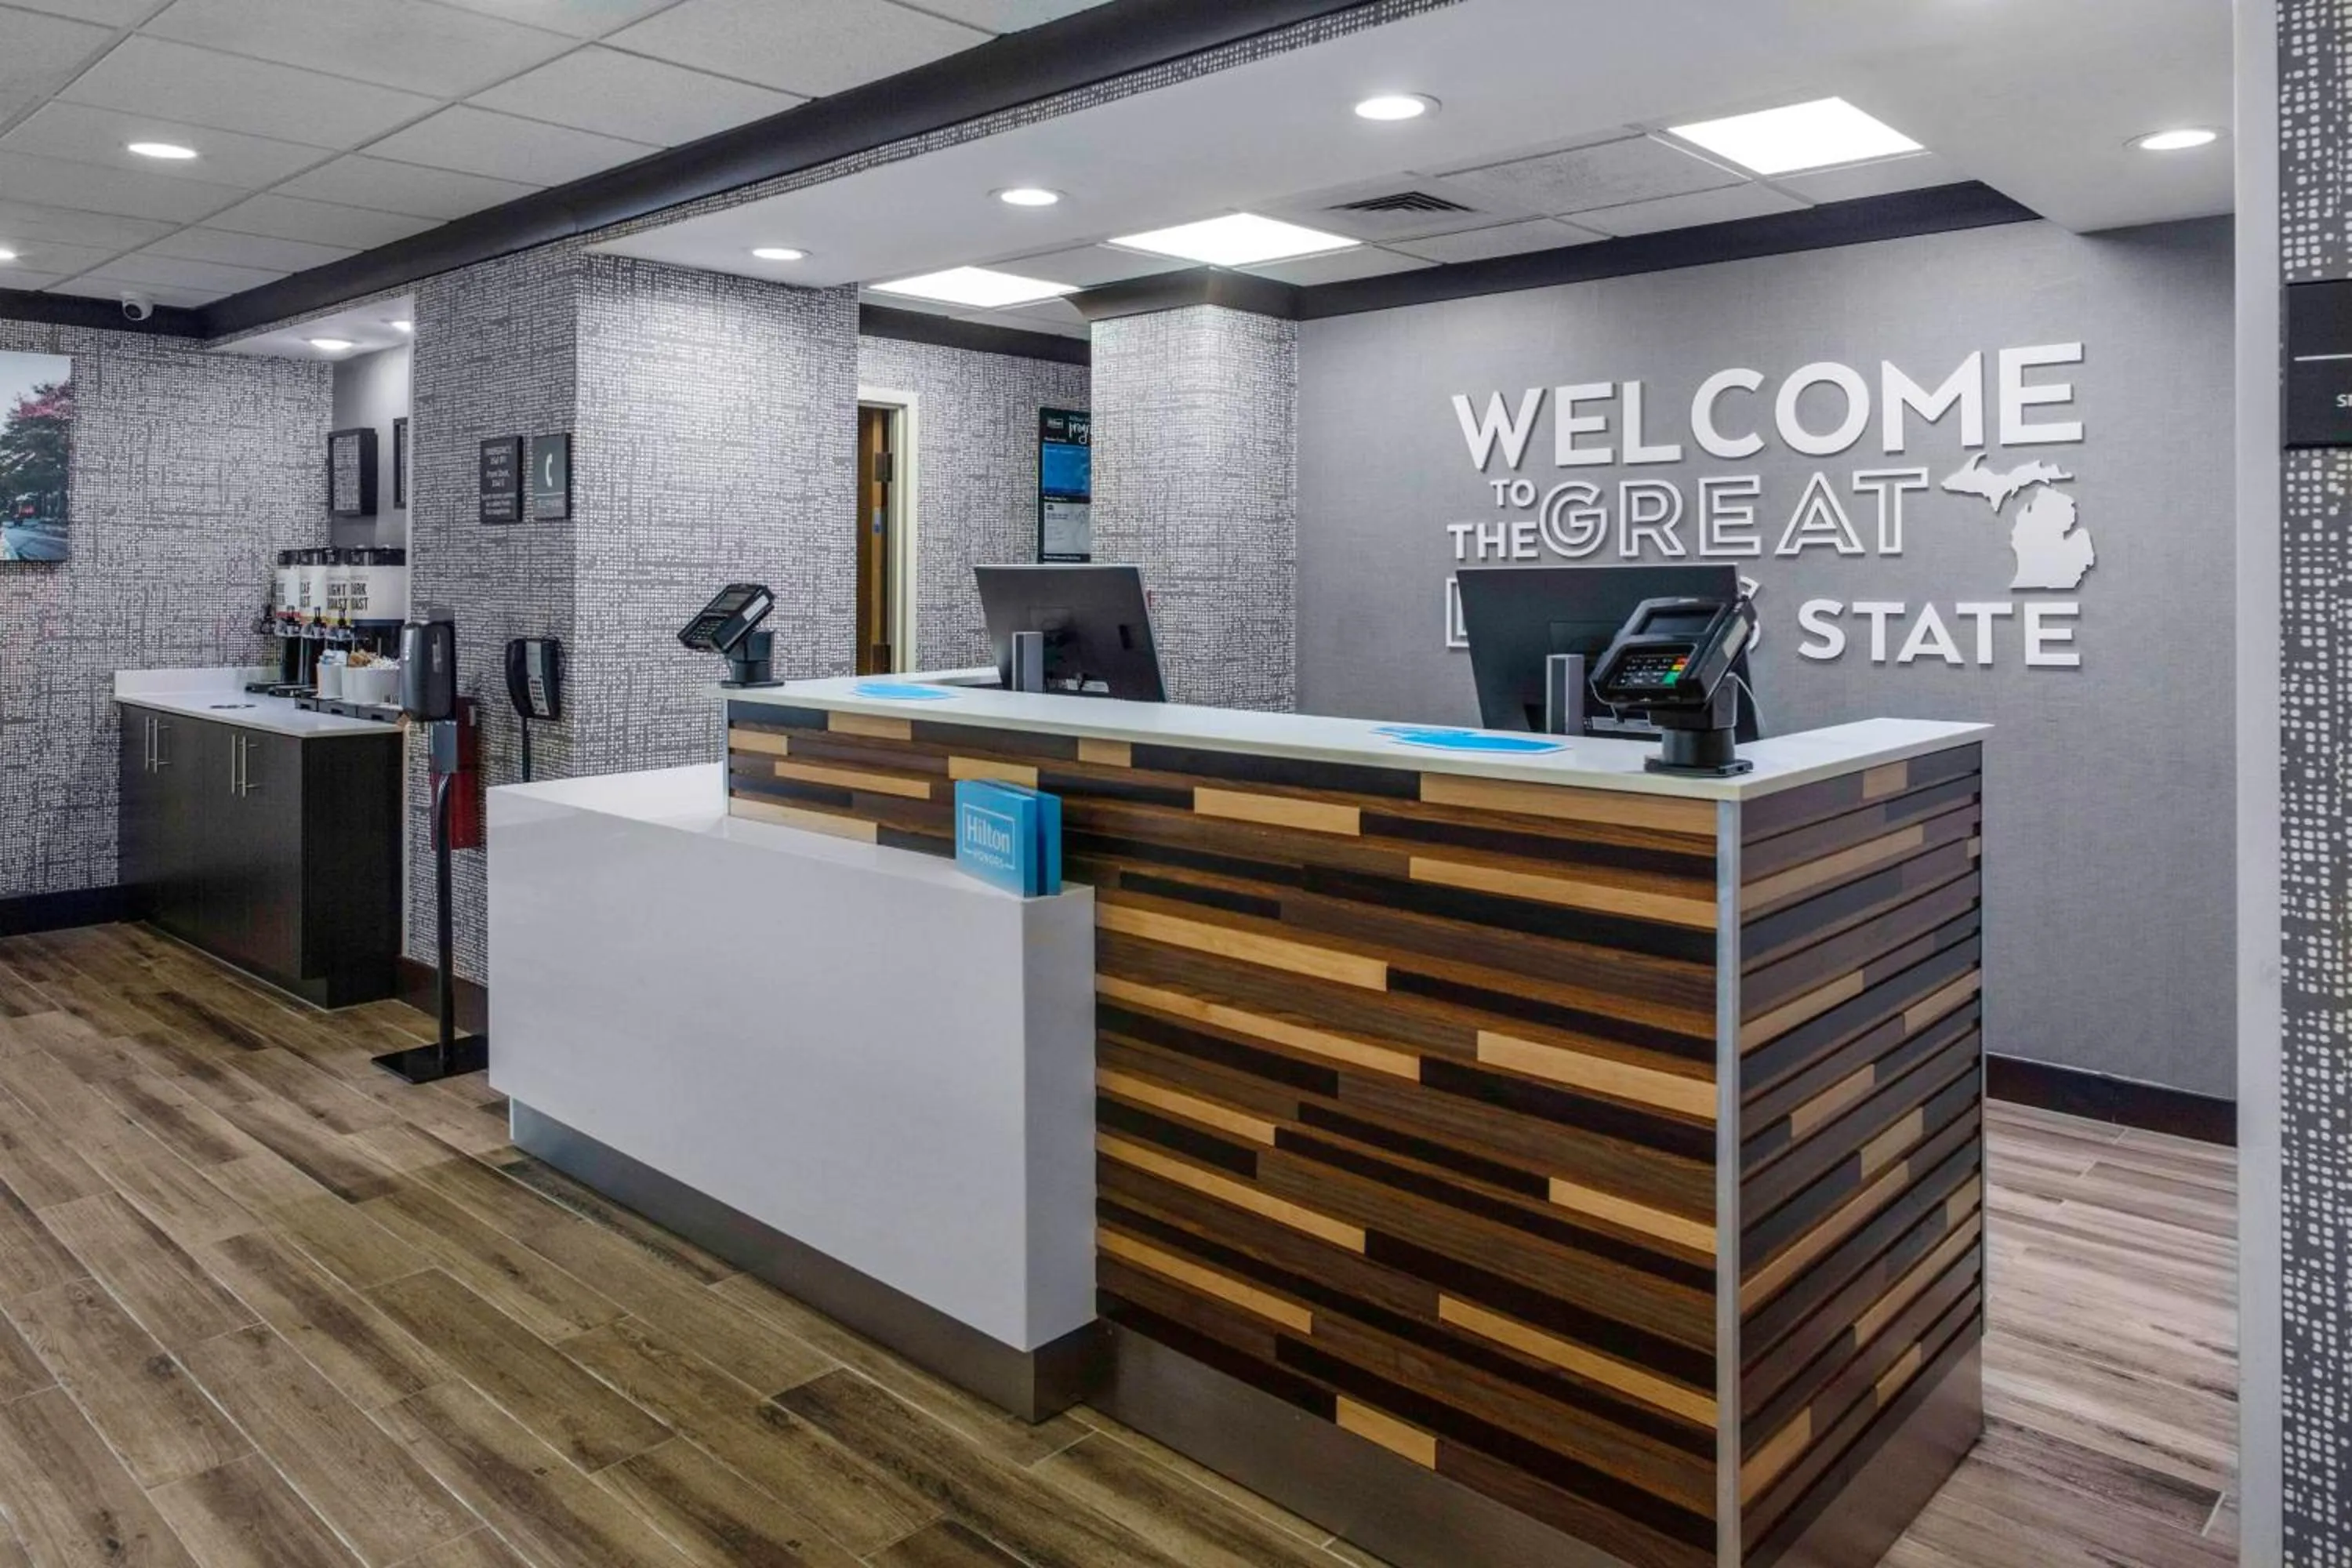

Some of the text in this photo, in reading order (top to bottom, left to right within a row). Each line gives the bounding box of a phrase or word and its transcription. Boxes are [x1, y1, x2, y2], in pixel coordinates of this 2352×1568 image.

[1450, 340, 2084, 470] WELCOME
[1446, 466, 1930, 559] THE GREAT
[1489, 478, 1535, 507] TO
[1798, 598, 2082, 666] STATE
[967, 814, 1011, 855] Hilton
